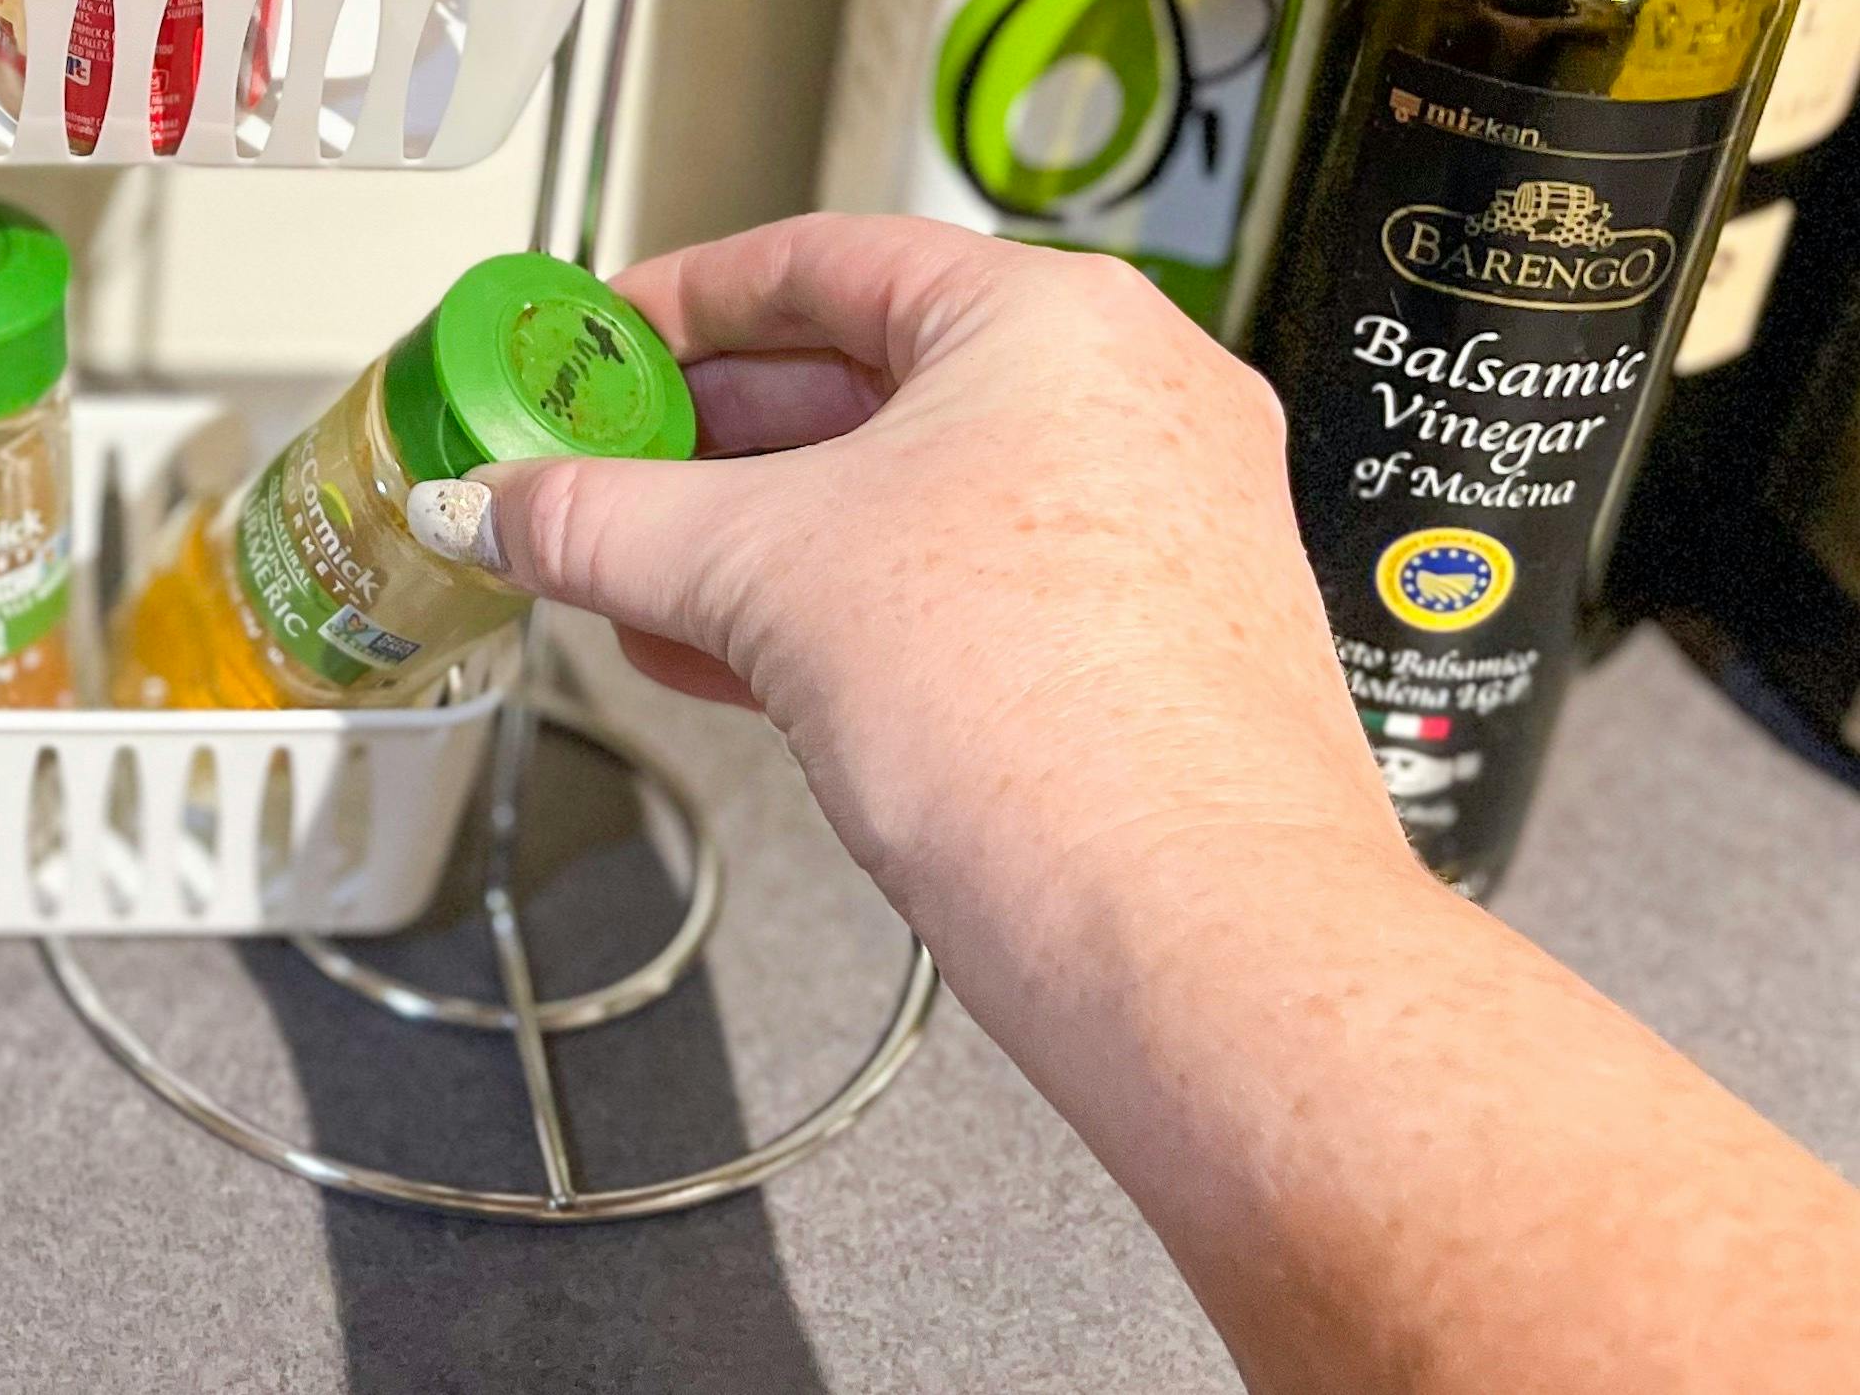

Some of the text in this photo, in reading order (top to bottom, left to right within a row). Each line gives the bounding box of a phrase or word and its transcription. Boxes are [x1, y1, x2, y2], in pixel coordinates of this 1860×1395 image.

[1426, 102, 1541, 148] mizkan
[1405, 220, 1656, 291] BARENGO
[1352, 314, 1647, 398] Balsamic
[1371, 382, 1607, 475] Vinegar
[1353, 451, 1577, 509] of Modena
